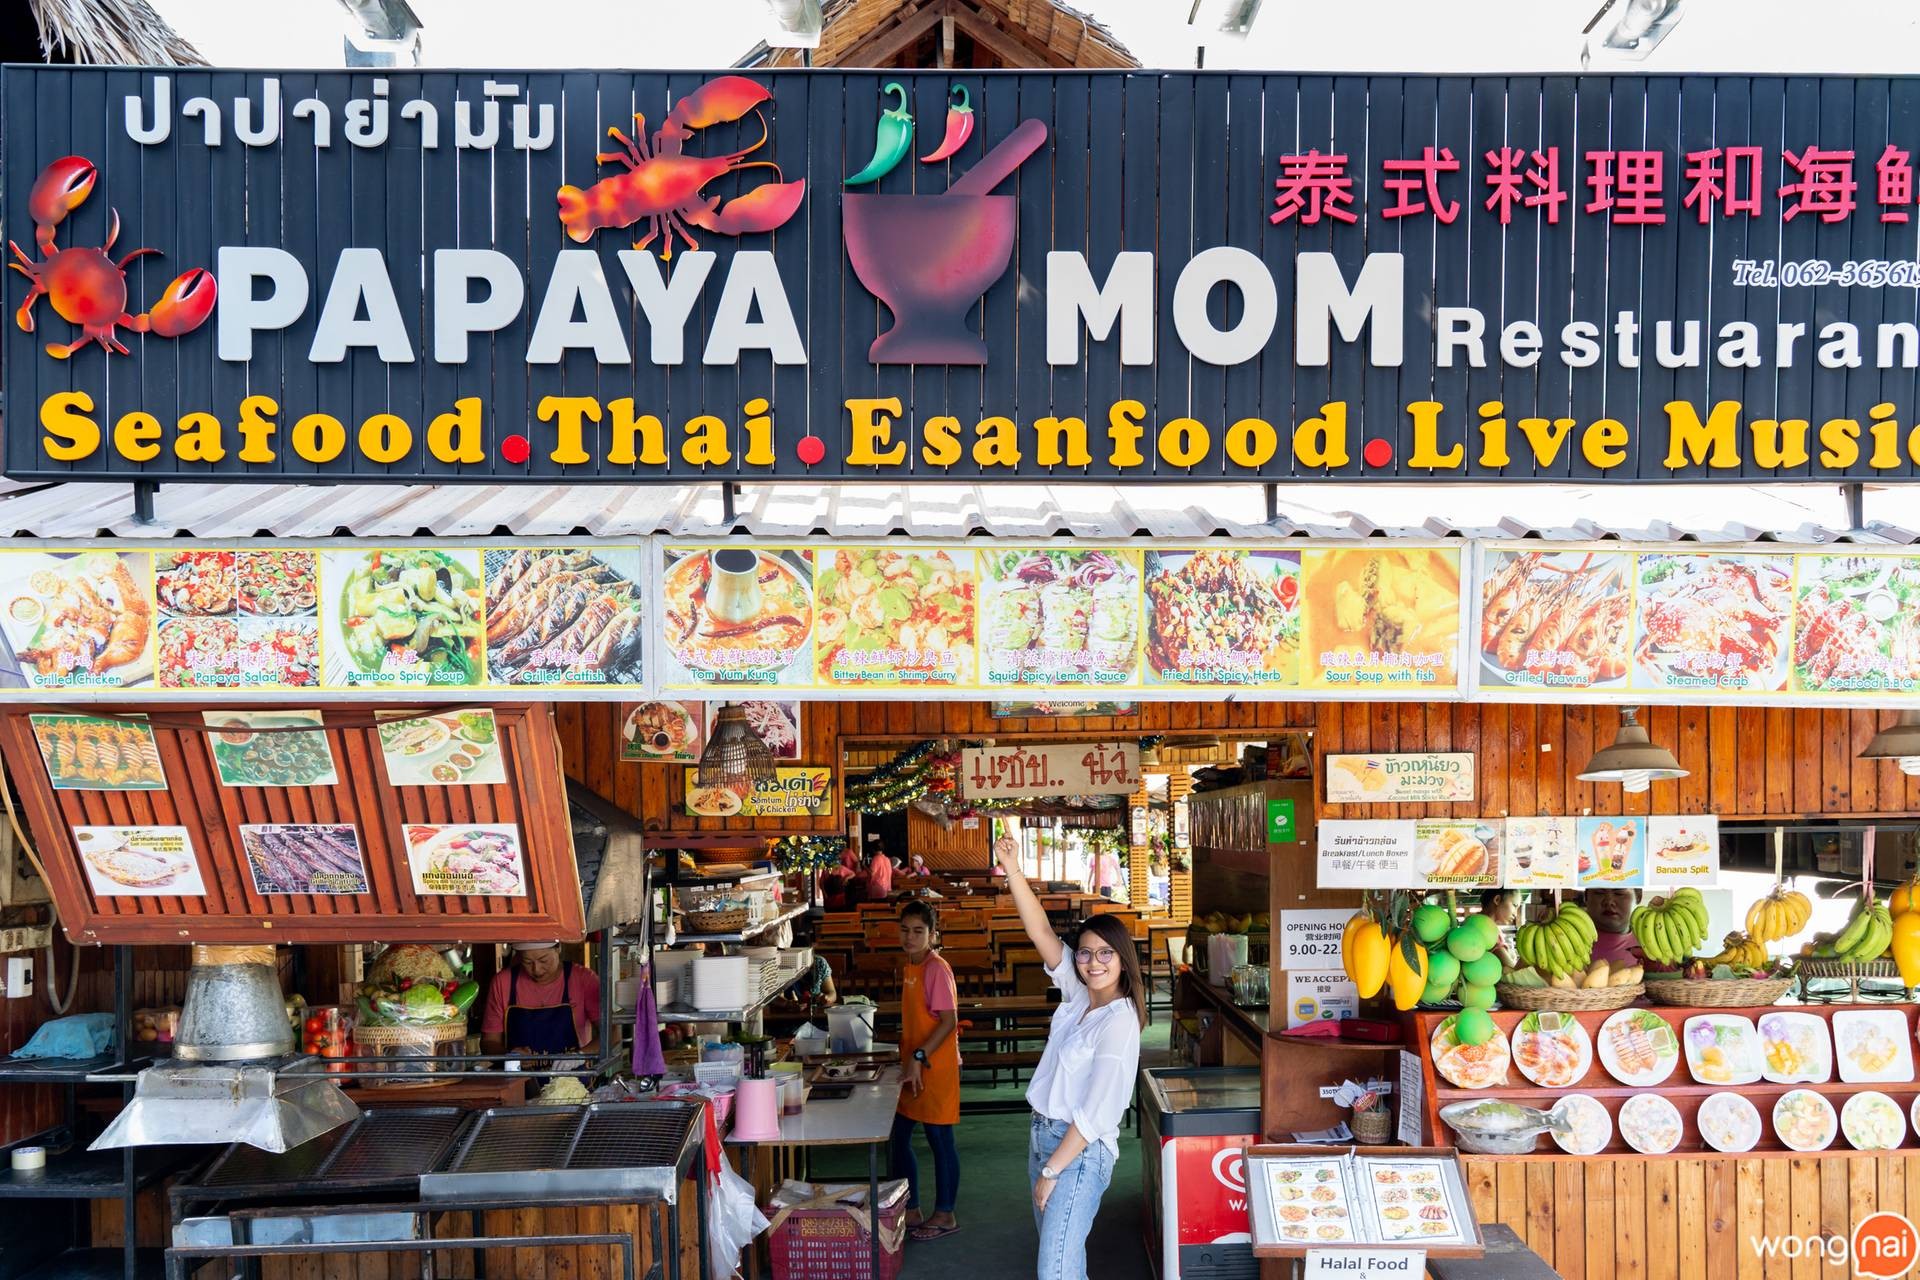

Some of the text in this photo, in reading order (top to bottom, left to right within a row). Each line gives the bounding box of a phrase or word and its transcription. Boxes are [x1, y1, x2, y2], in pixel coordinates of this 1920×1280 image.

[124, 75, 555, 151] ปาปาย่ามัม
[1732, 258, 1777, 287] Tel.
[217, 245, 808, 366] PAPAYA
[1046, 246, 1404, 368] MOM
[1406, 400, 1628, 469] Live
[33, 672, 122, 685] Grilled Chicken
[196, 671, 277, 685] Papaya Salad
[347, 670, 464, 684] Bamboo Spicy Soup
[522, 669, 606, 682] Grilled Catfish
[691, 669, 777, 683] Tom Yum Kung
[833, 670, 956, 683] Bitter Bean in Shrimp Curry
[988, 670, 1127, 683] Squid Spicy Lemon Sauce
[1162, 669, 1281, 684] Fried fish Spicy Herb
[1326, 669, 1435, 684] Sour Soup with fish
[1505, 671, 1588, 683] Grilled Prawns
[1666, 674, 1749, 686] Steamed Crab
[1400, 772, 1445, 786] มะม่วง
[766, 805, 796, 813] Chicken
[1386, 849, 1409, 857] Boxes
[1656, 865, 1710, 875] Banana Split
[1286, 923, 1326, 931] OPENING
[1289, 944, 1341, 955] 9.00-22.
[1295, 975, 1311, 983] WE
[1320, 1257, 1409, 1270] Halal Food
